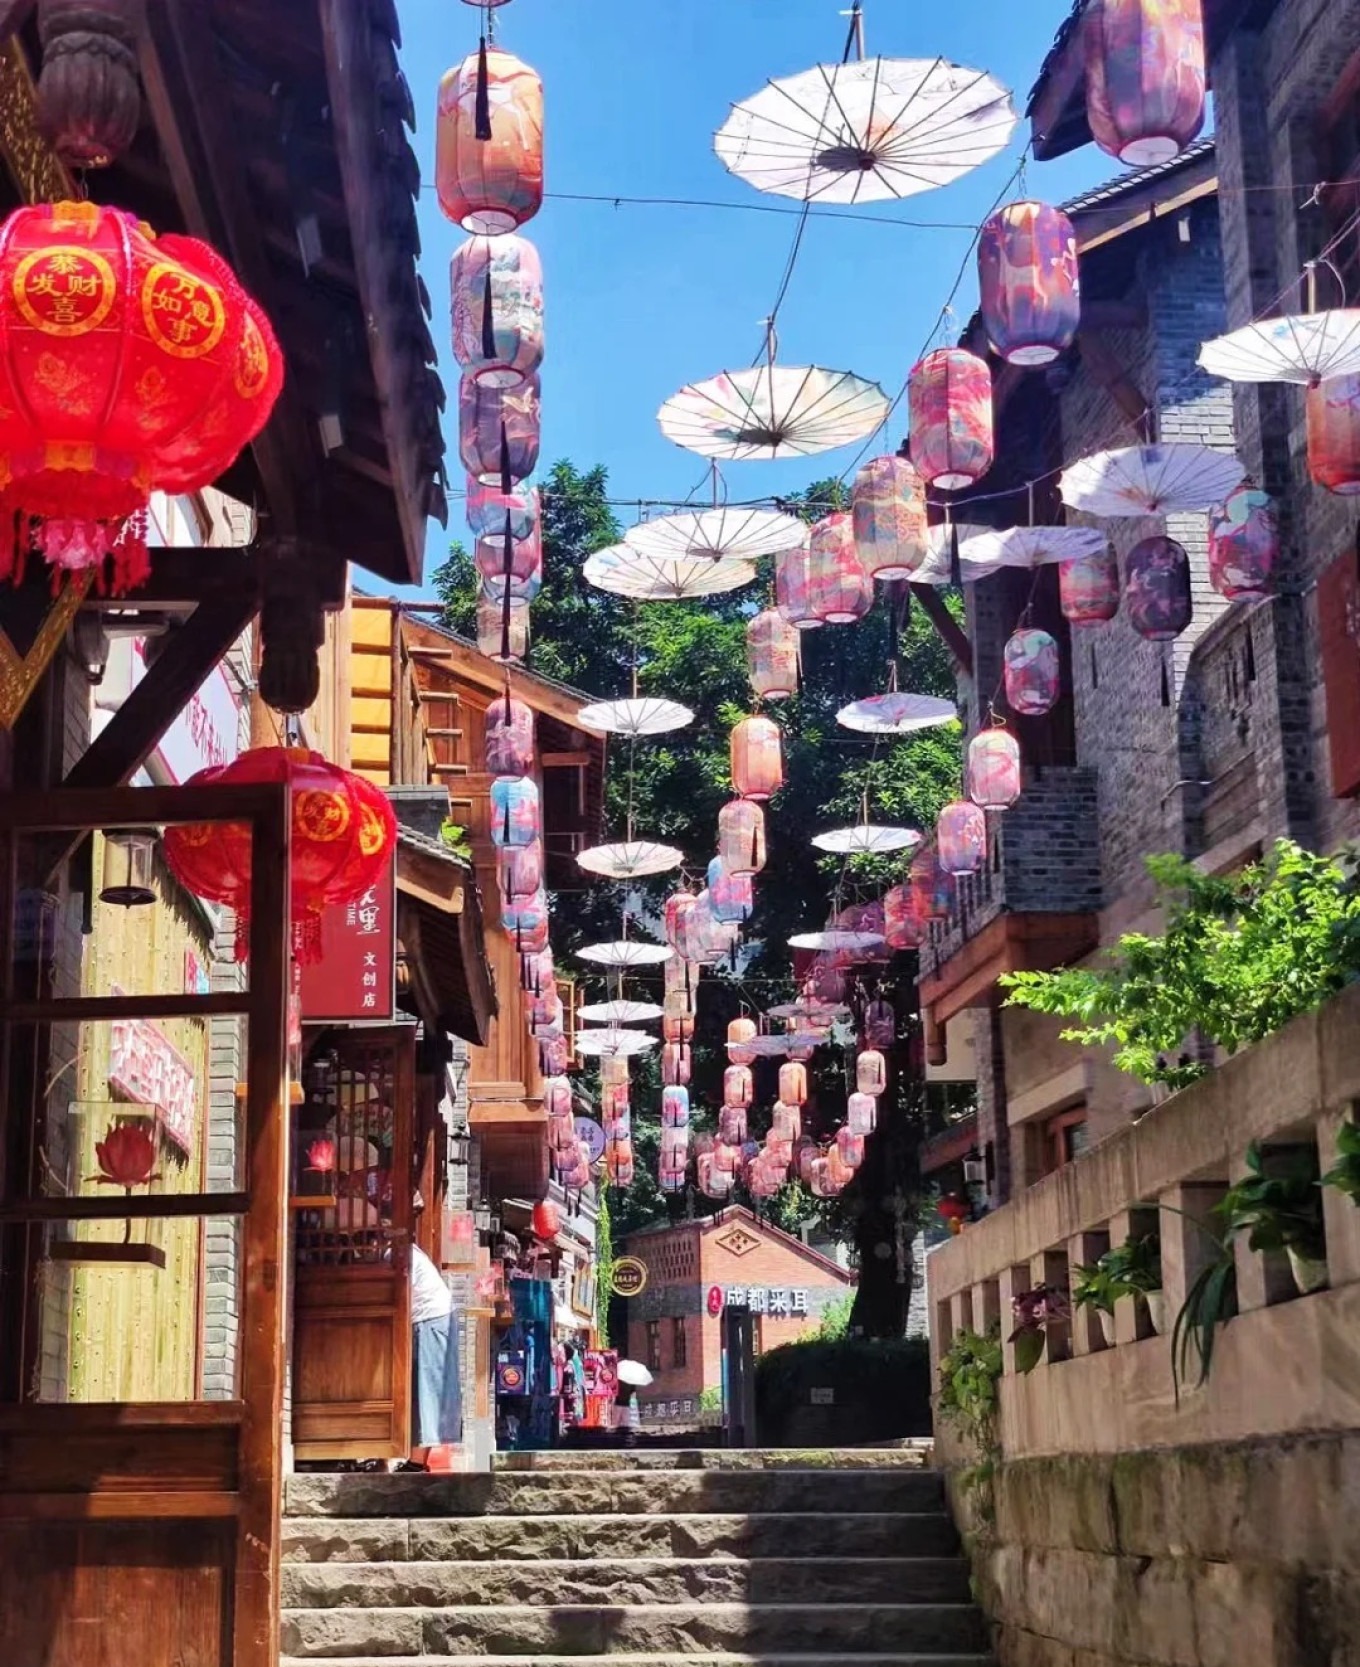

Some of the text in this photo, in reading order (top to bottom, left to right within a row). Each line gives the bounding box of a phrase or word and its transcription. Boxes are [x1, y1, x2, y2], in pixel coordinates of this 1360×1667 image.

[362, 951, 376, 1007] 文创店
[727, 1286, 808, 1313] 成都采耳
